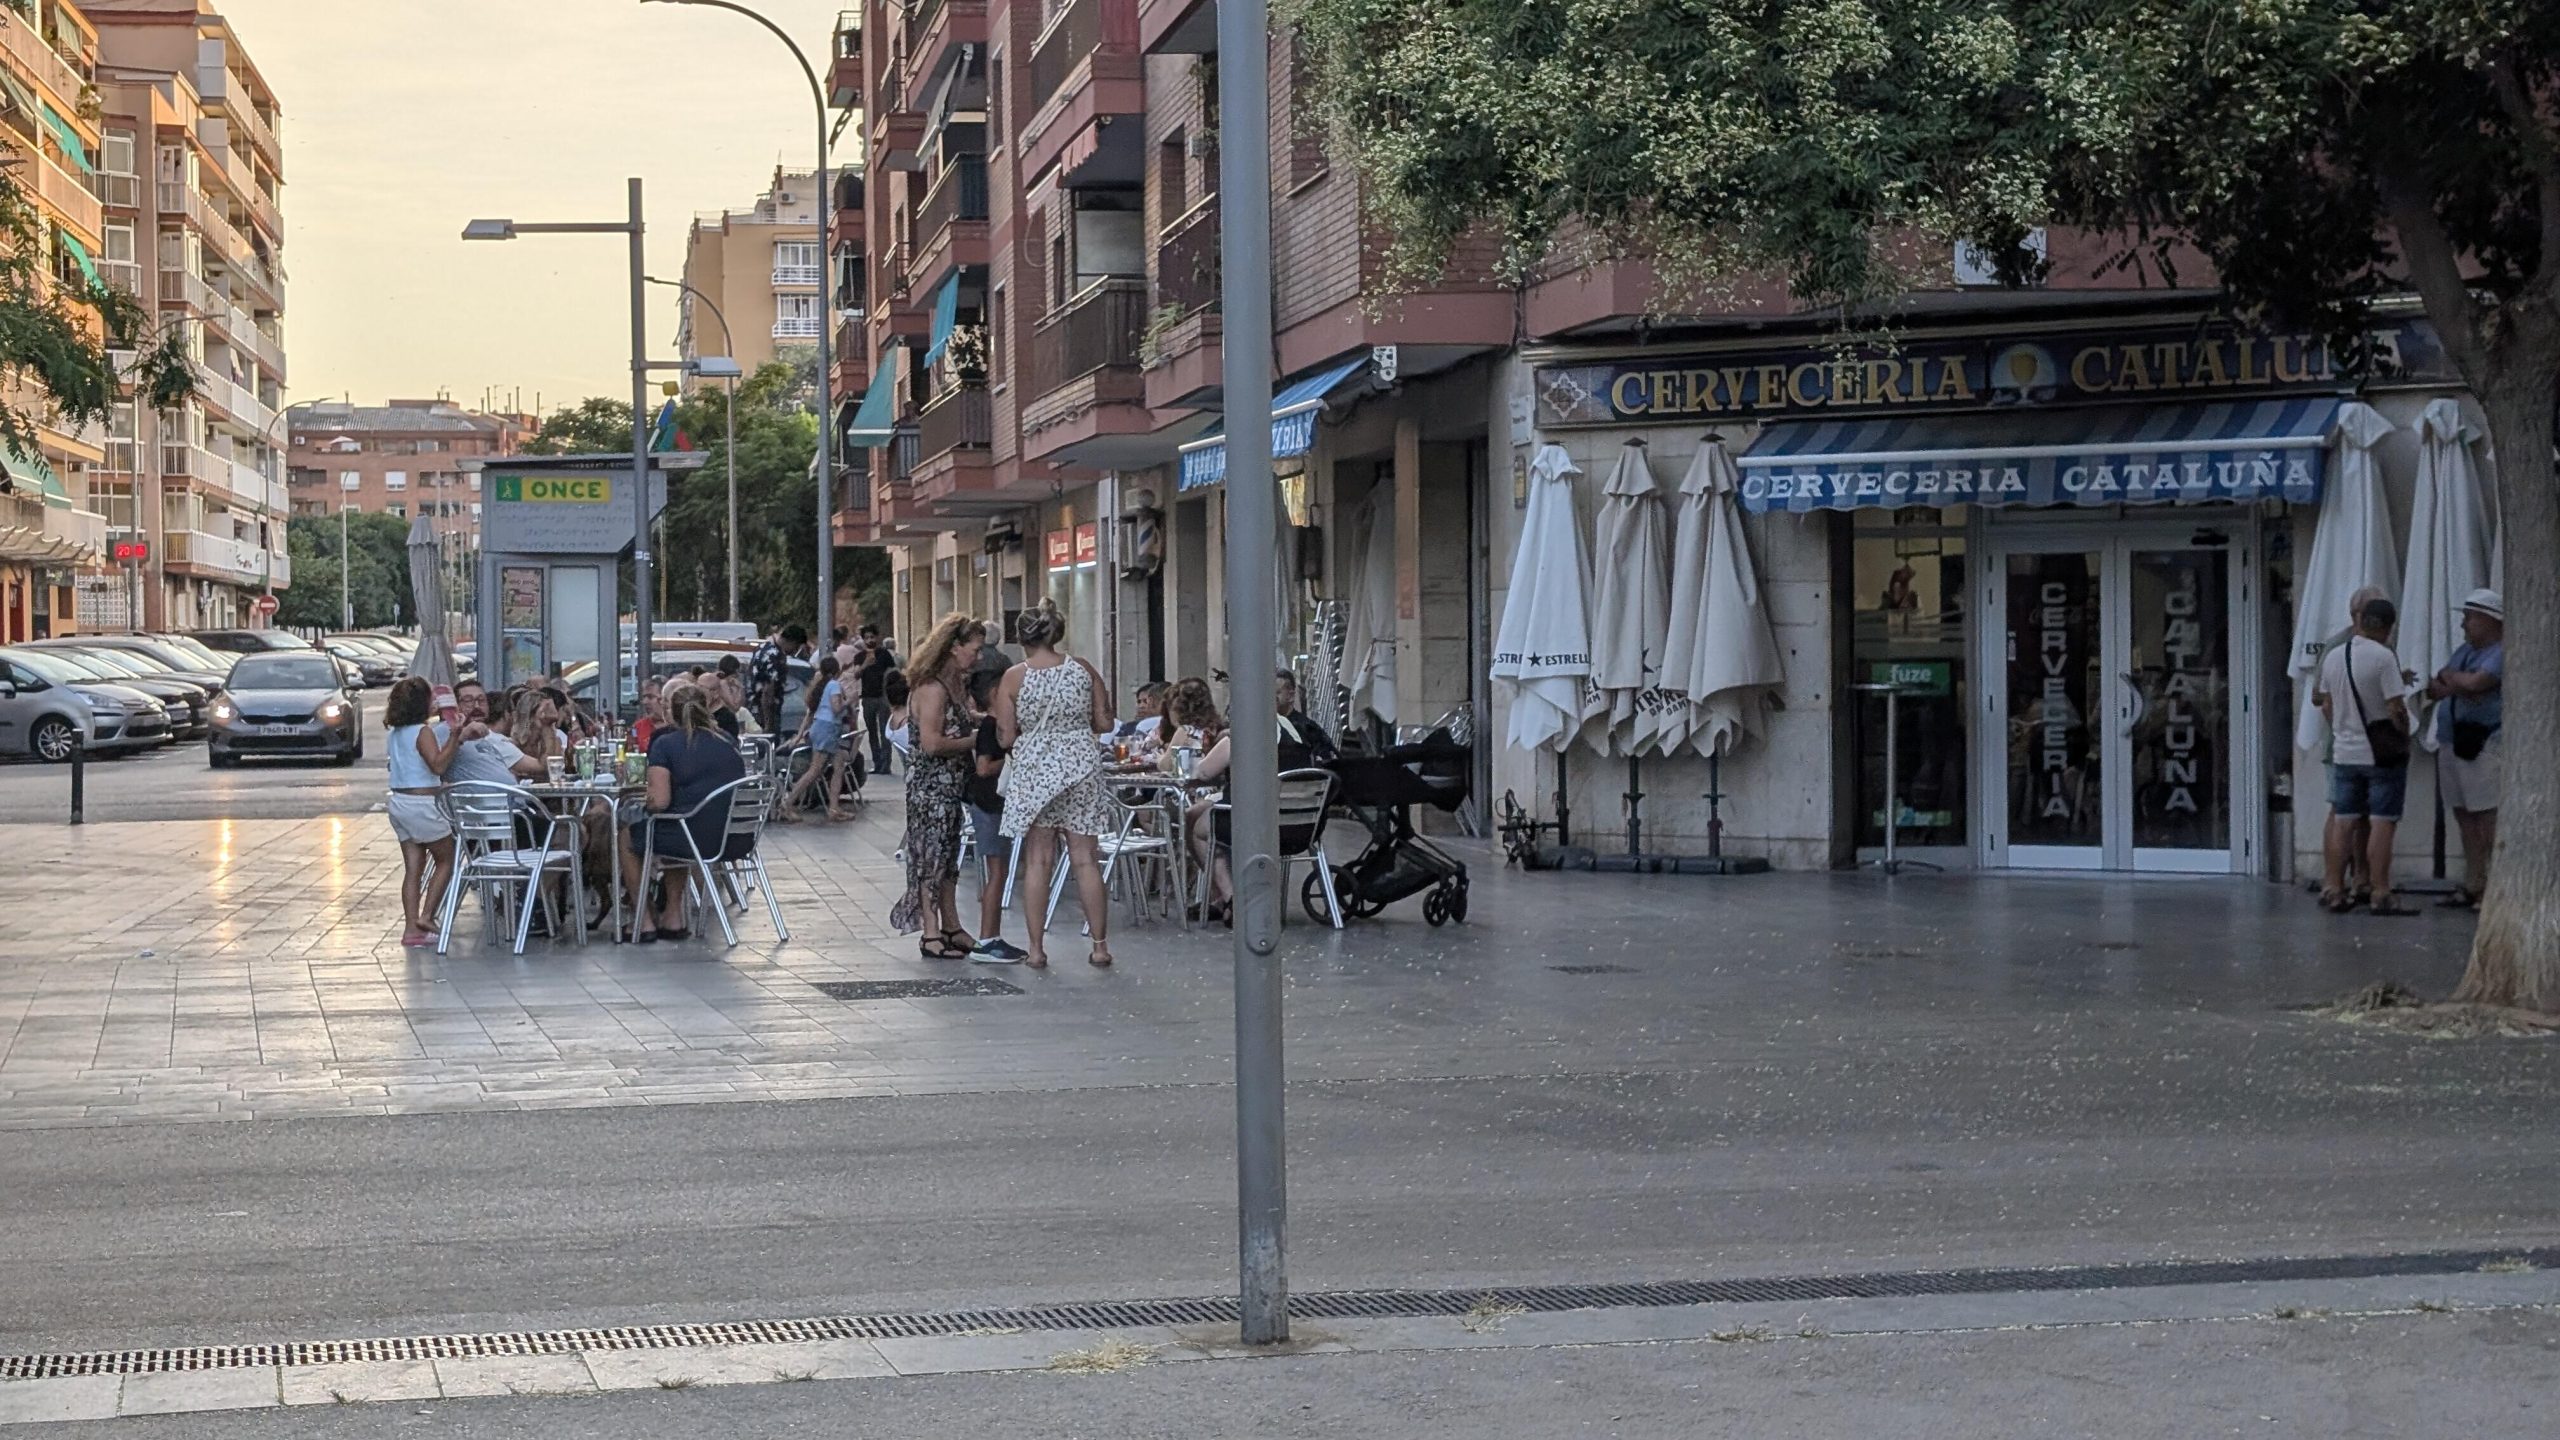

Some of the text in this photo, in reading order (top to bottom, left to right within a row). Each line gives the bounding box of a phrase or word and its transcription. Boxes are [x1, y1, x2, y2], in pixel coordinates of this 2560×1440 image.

[1611, 355, 1976, 415] CERVECERIA
[531, 481, 602, 498] ONCE
[1742, 451, 2314, 500] CERVECERIA CATALUÑA
[2042, 582, 2070, 818] CERVECERIA
[2164, 591, 2199, 812] CATALUÑA
